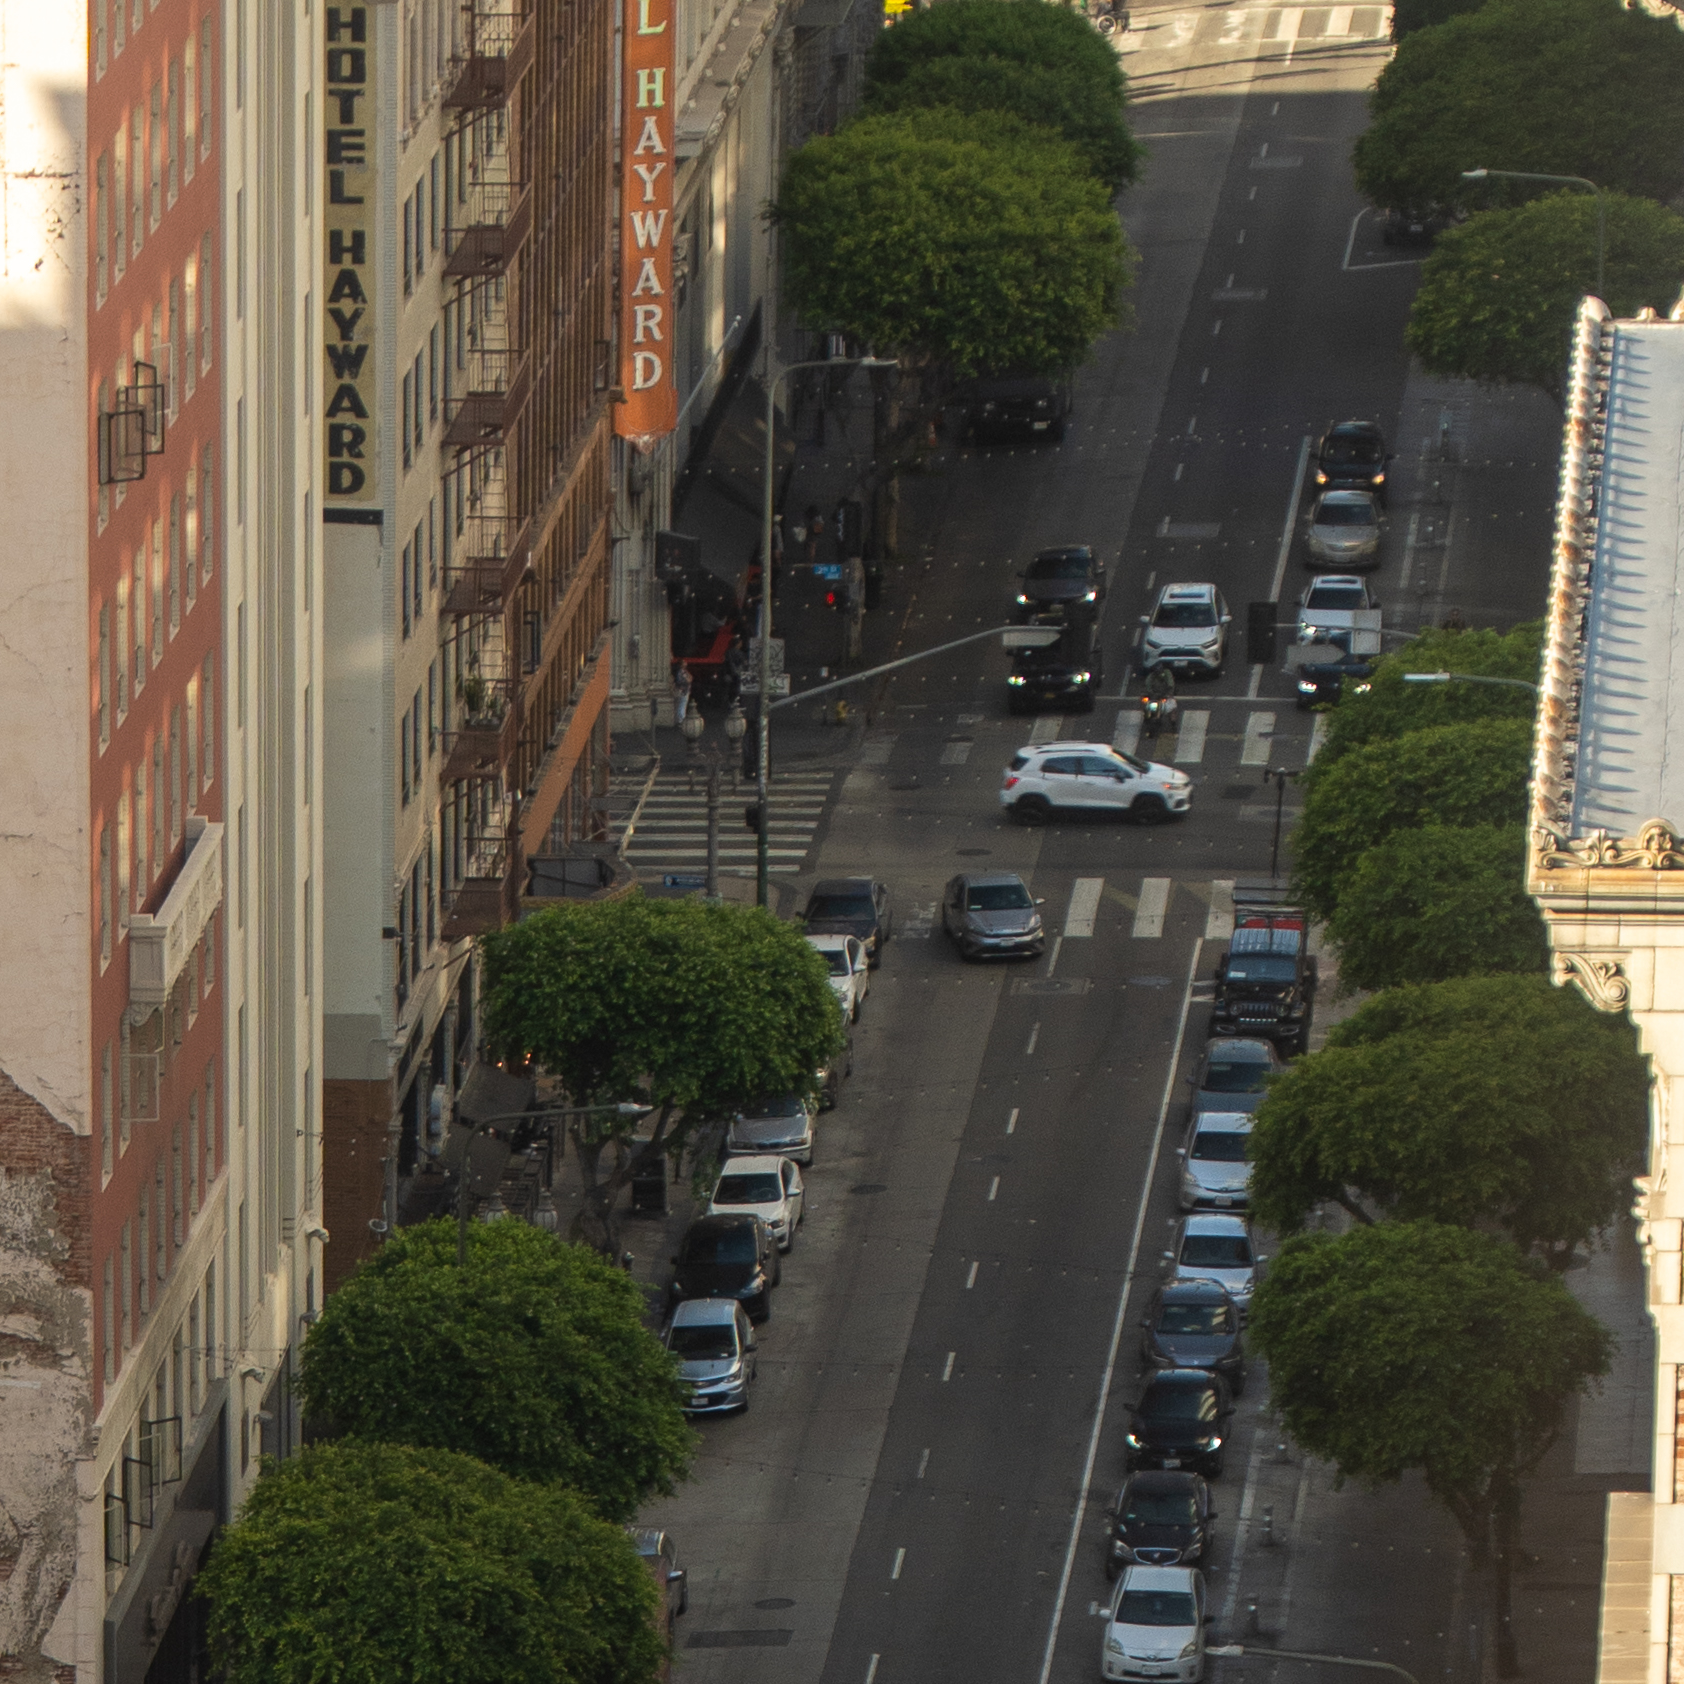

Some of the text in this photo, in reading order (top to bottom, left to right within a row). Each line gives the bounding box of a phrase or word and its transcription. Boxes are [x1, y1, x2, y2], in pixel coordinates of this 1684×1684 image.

[325, 7, 369, 496] HOTEL HAYWARD
[630, 67, 668, 390] HAYWARD
